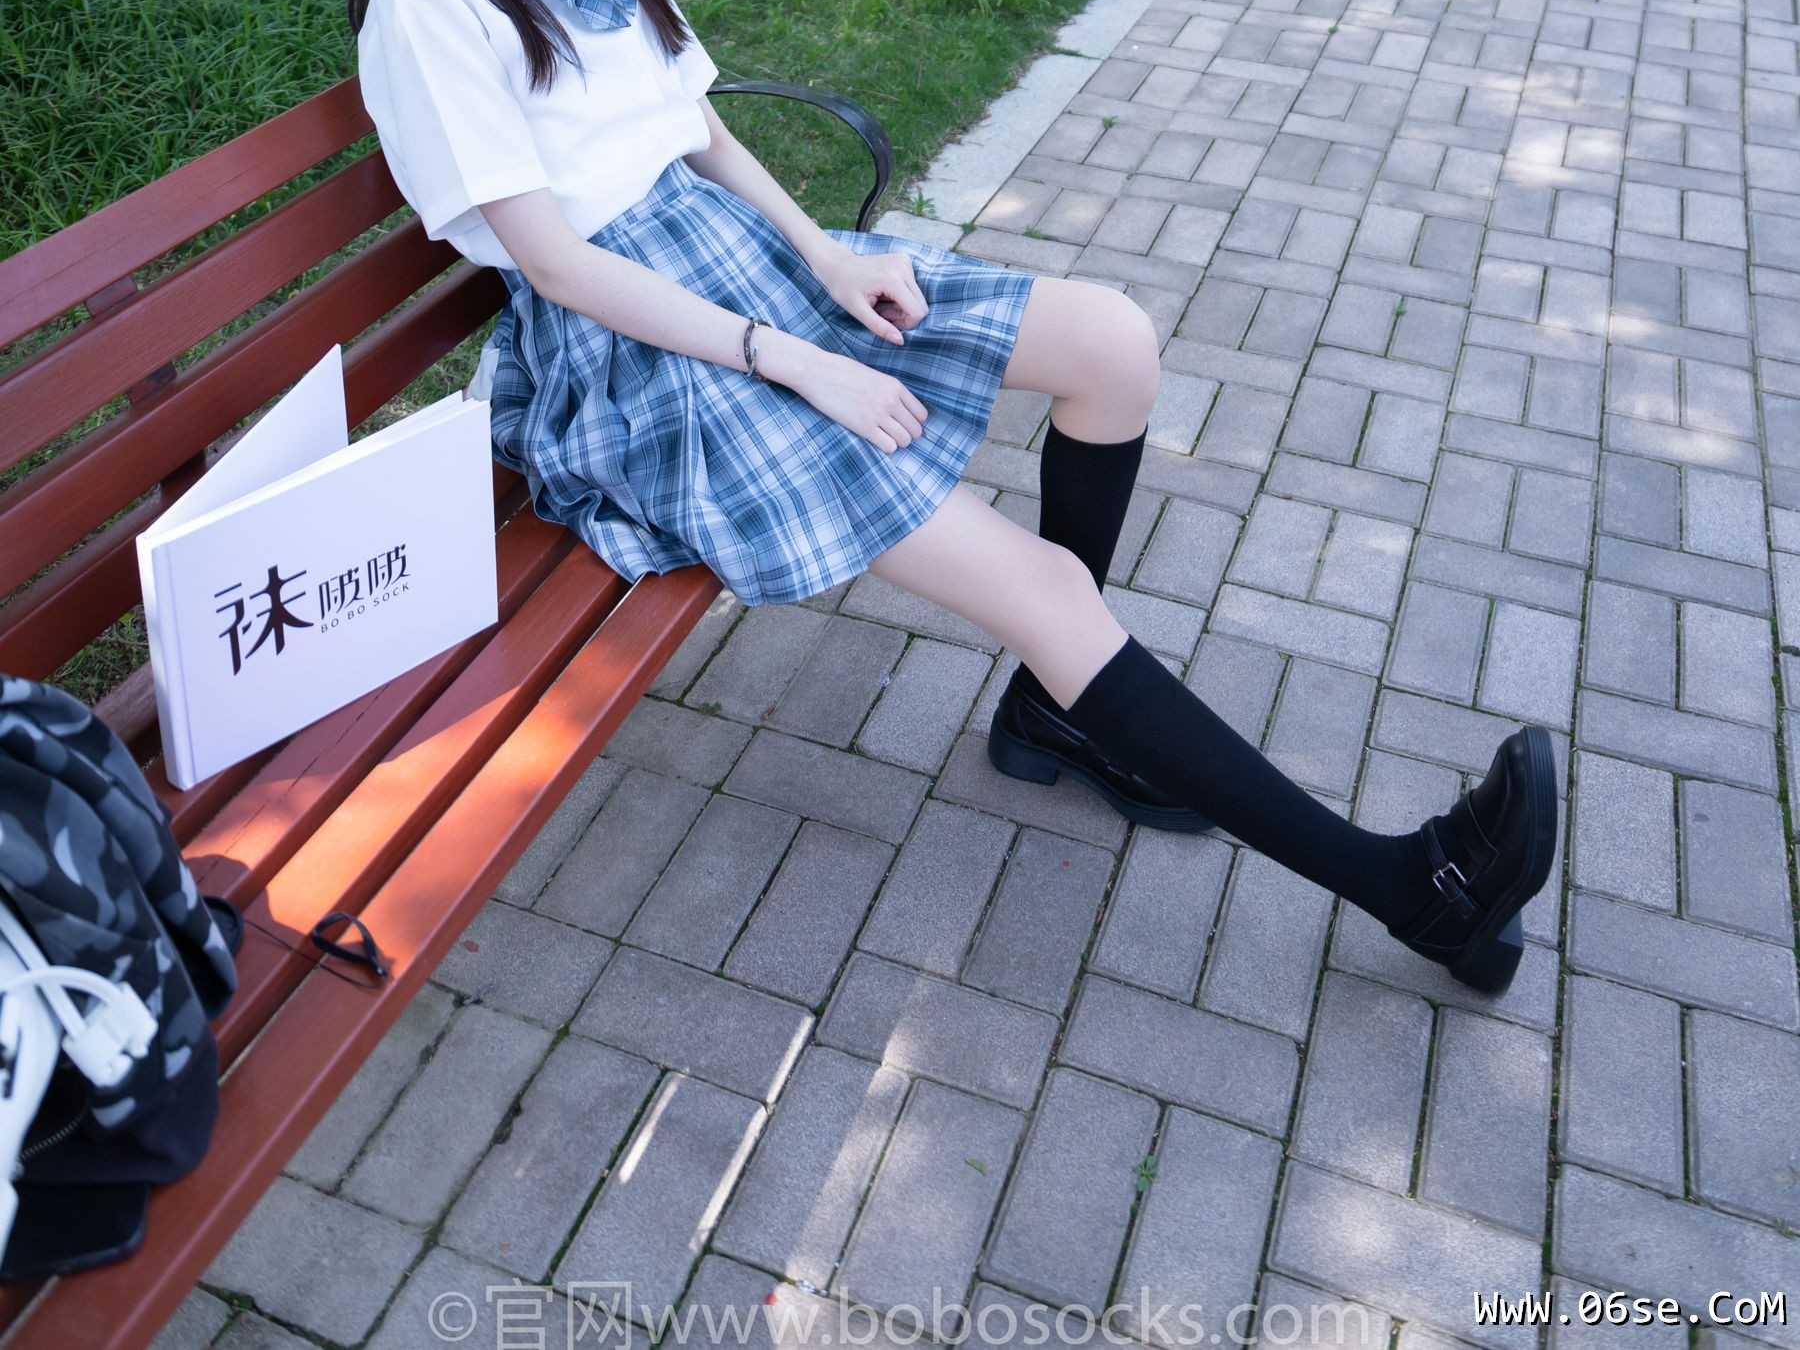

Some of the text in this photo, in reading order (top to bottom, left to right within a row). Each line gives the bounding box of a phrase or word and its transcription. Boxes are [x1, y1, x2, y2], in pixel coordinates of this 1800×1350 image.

[320, 582, 410, 634] BO BO SOCK
